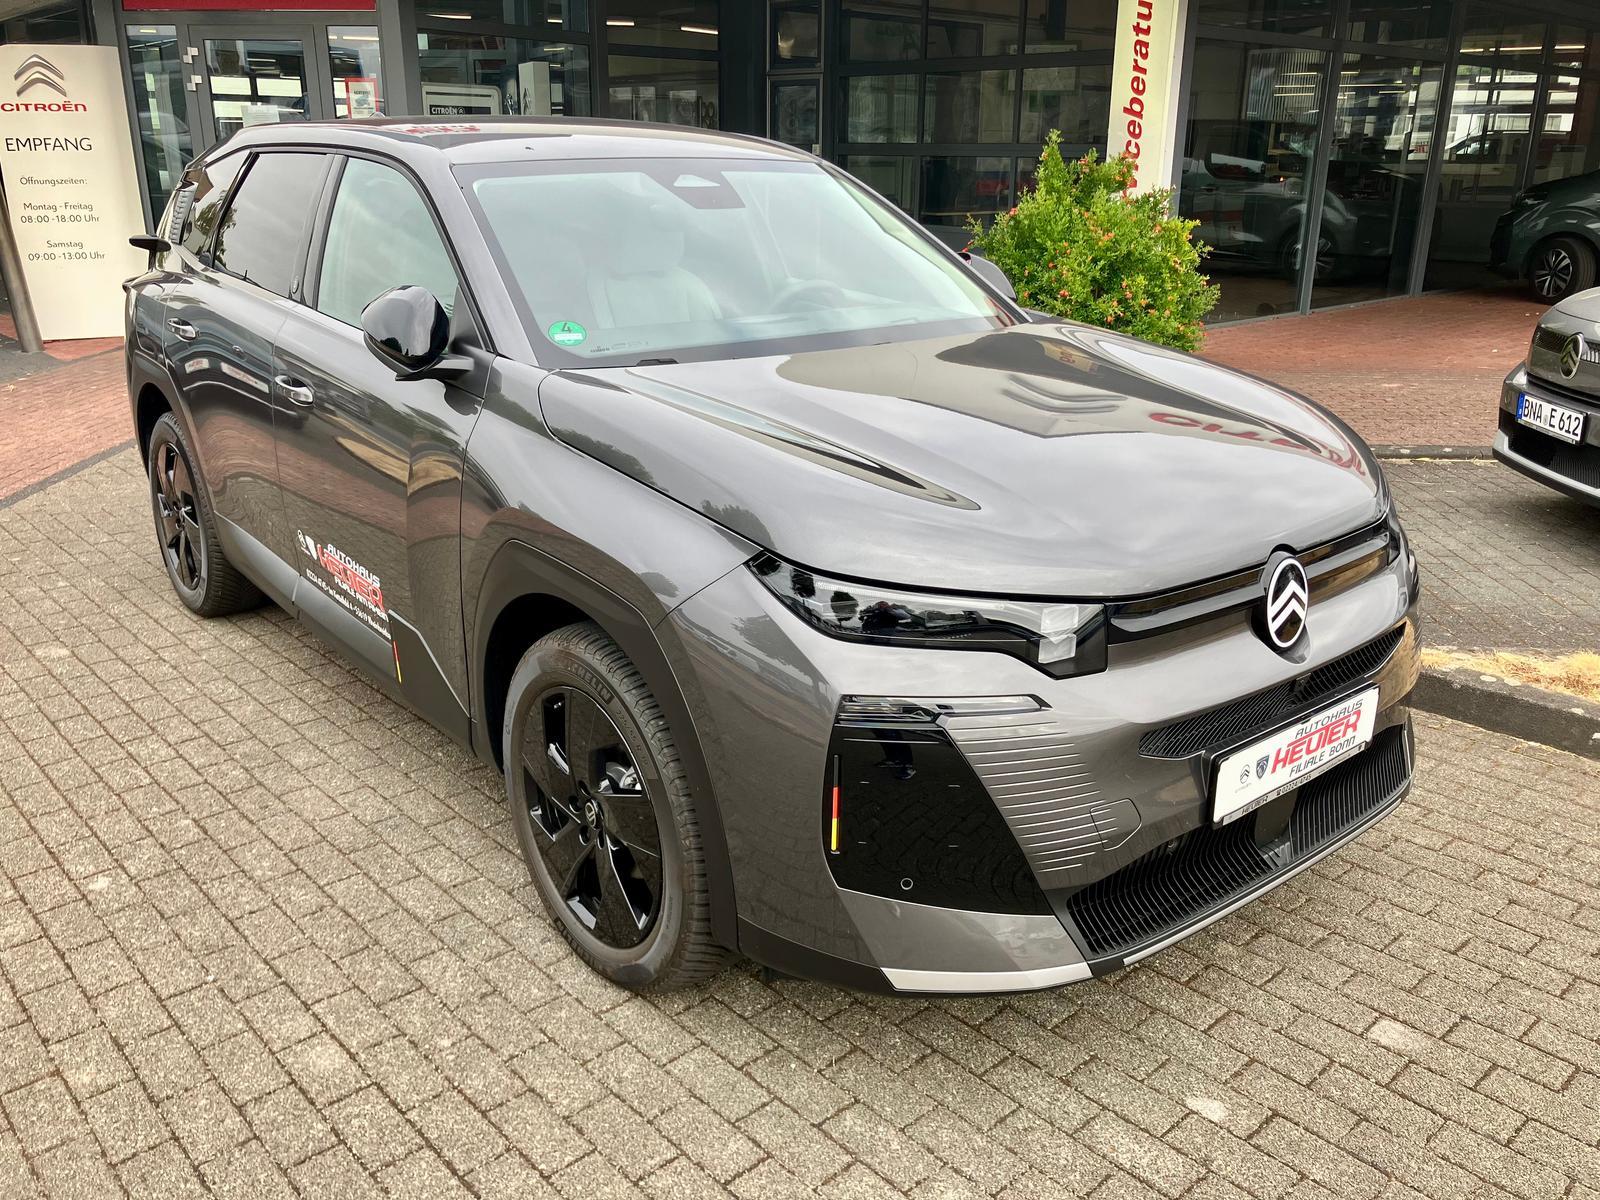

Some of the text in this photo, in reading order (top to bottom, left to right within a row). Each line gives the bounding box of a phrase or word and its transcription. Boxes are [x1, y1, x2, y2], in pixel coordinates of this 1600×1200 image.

[0, 100, 88, 112] CITROËN
[5, 137, 93, 152] EMPFANG
[19, 175, 88, 187] Öffnungszeiten:
[23, 202, 58, 213] Montag
[64, 202, 94, 212] Freitag
[20, 215, 50, 224] 08:00
[84, 214, 100, 223] Uhr
[46, 240, 84, 249] Samstag
[28, 253, 57, 261] 09:00
[89, 251, 105, 260] Uhr
[561, 322, 573, 334] 4
[1523, 398, 1581, 436] BNA E 612
[327, 543, 381, 588] AUTOHAUS
[1295, 699, 1364, 739] AUTOHAUS
[1271, 709, 1362, 774] HEUTER
[1289, 751, 1326, 777] FILIALE
